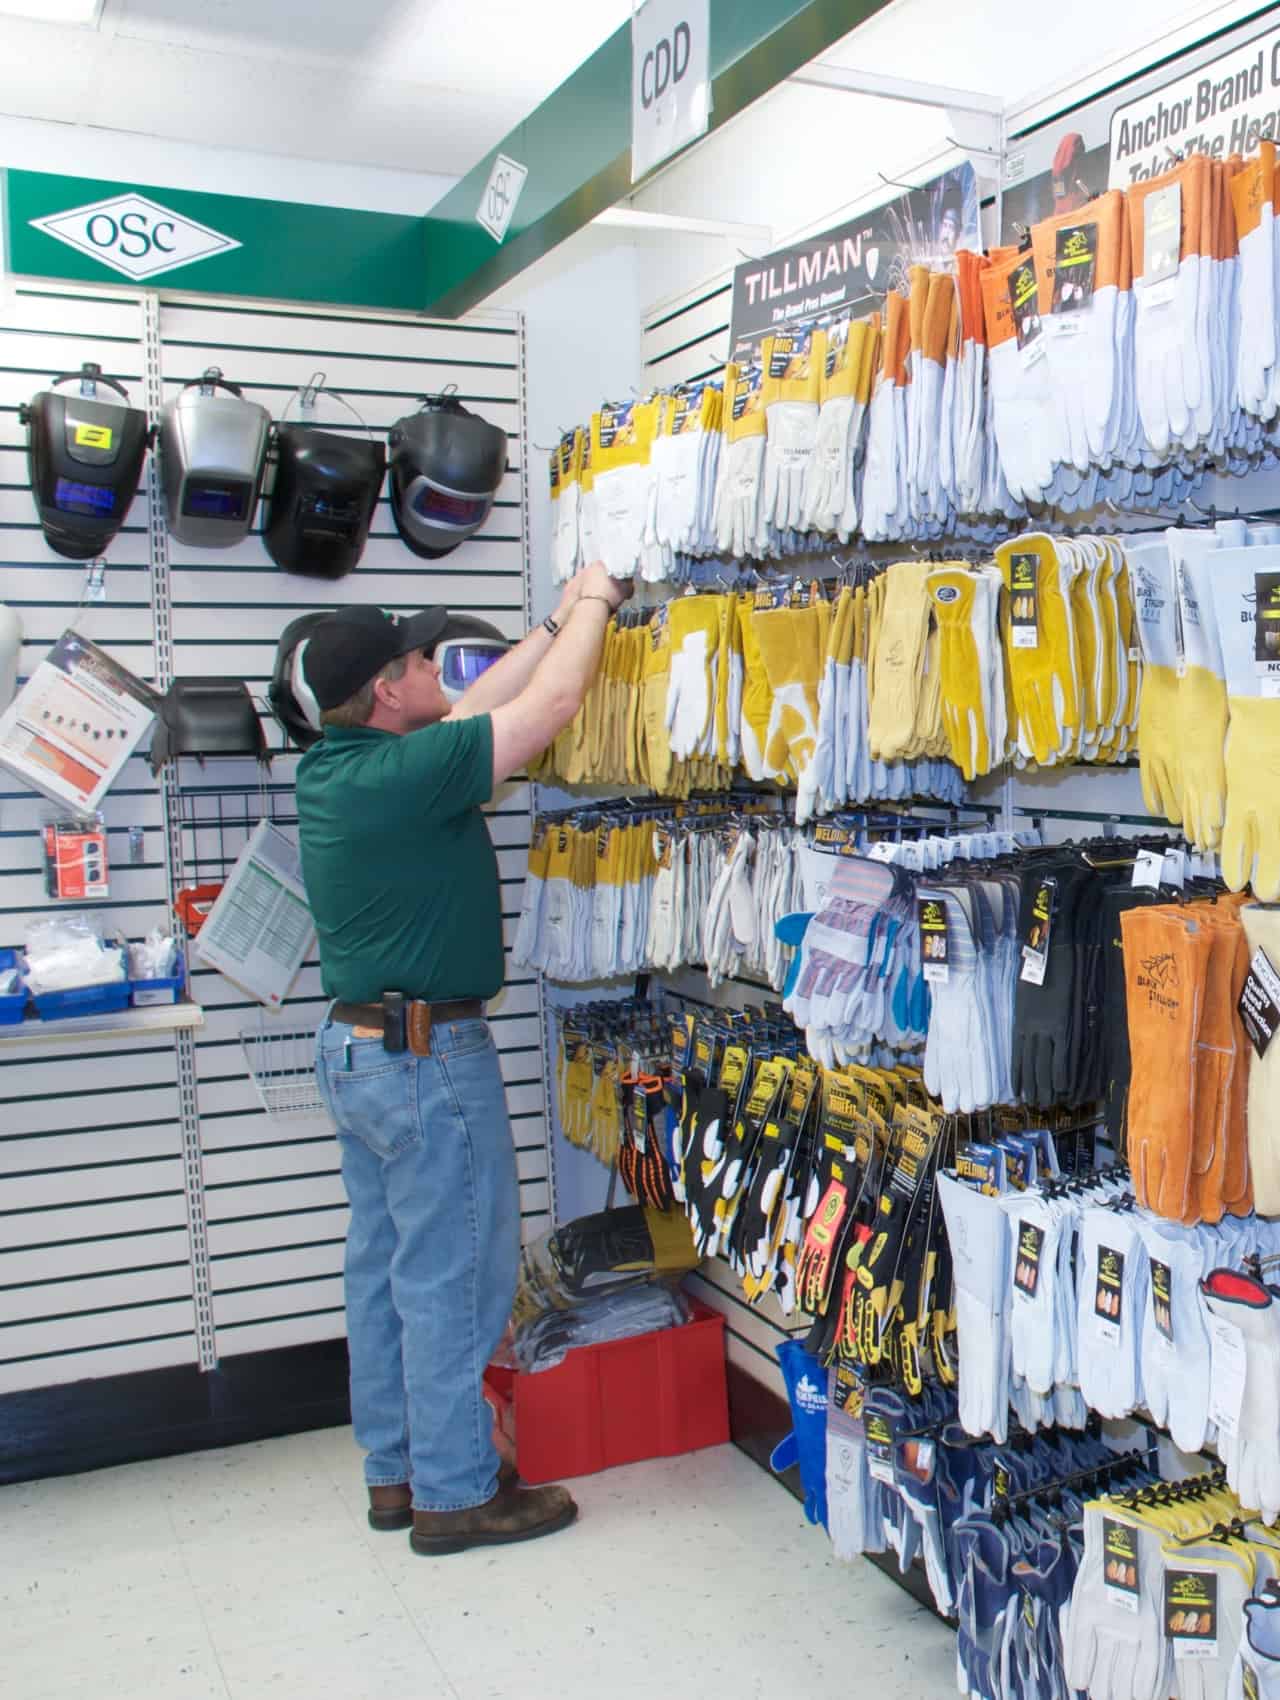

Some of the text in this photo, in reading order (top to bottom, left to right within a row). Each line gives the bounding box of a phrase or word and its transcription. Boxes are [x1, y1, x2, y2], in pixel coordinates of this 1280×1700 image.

[641, 21, 691, 109] CDD
[1116, 96, 1193, 160] Anchor
[1195, 50, 1264, 123] Brand
[86, 212, 177, 258] OSC
